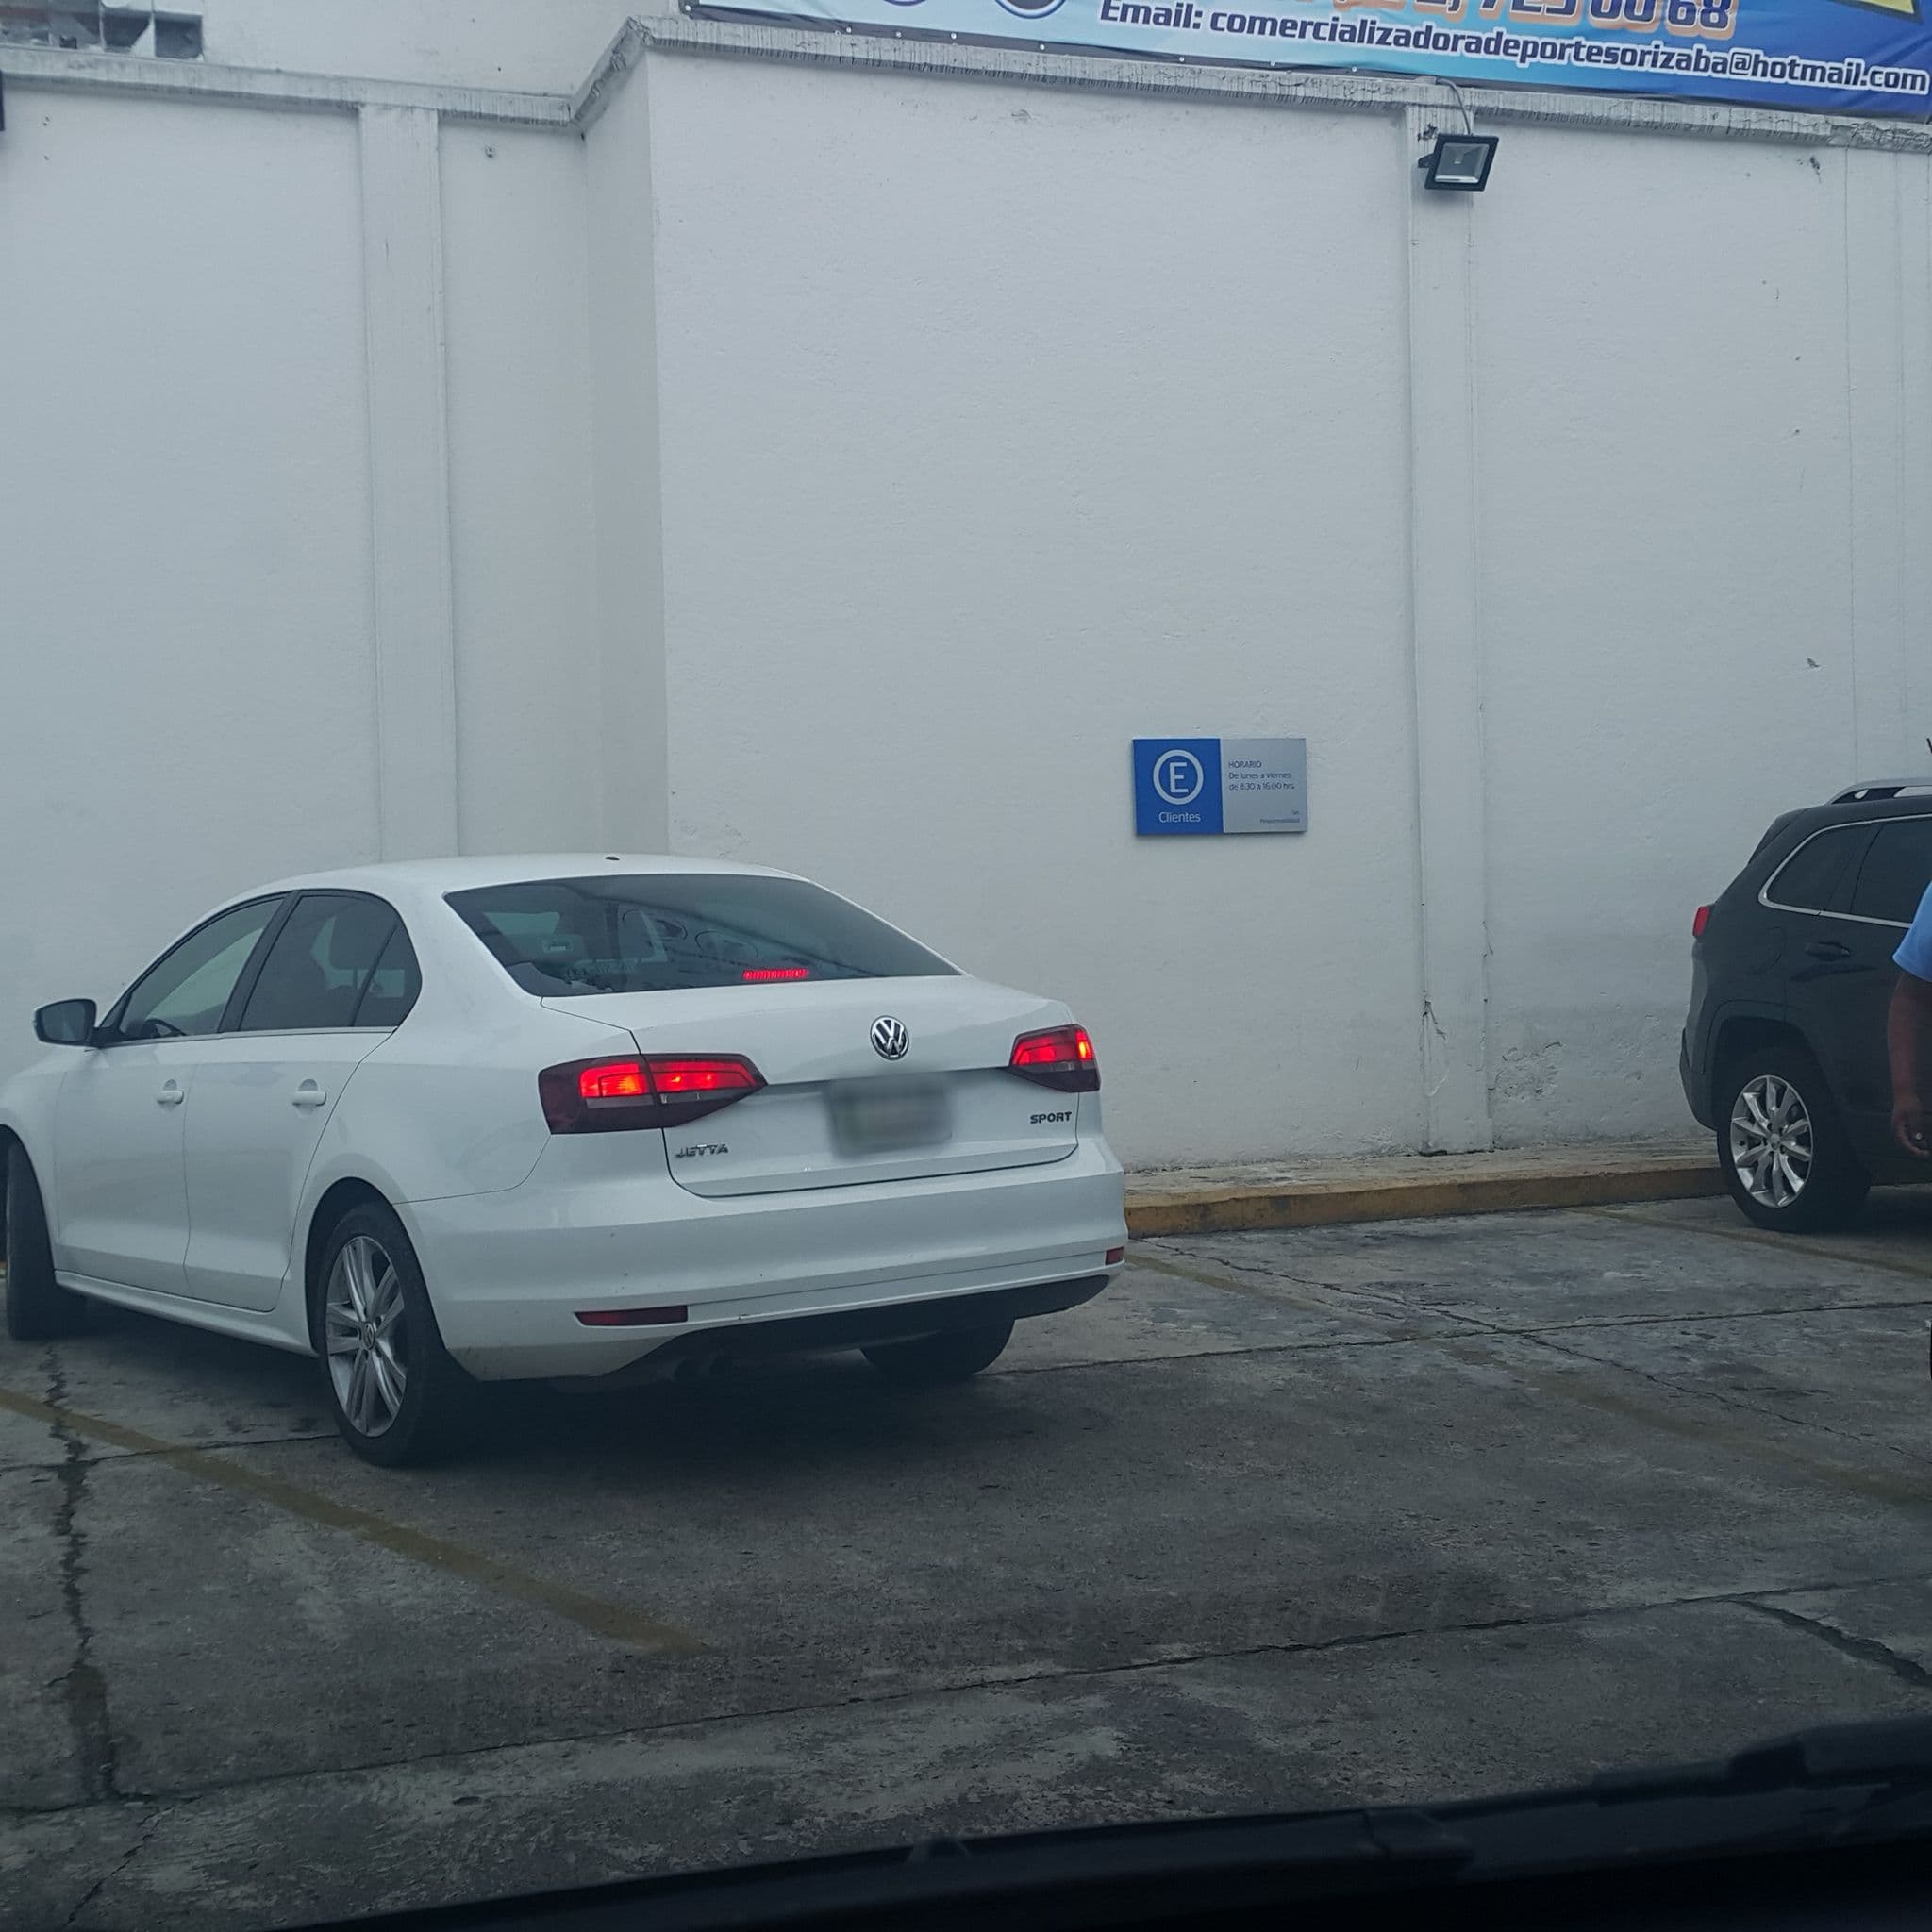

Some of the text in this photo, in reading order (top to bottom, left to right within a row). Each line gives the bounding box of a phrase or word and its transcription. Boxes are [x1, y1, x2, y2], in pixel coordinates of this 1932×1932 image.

[1100, 0, 1927, 92] Email: comercializadoradeportesorizaba@hotmail.com
[1228, 760, 1262, 769] HORARIO
[1169, 761, 1189, 793] E
[1228, 772, 1239, 780] De
[1228, 782, 1239, 791] de
[1158, 811, 1201, 824] Clientes
[1030, 1111, 1072, 1124] SPORT
[675, 1143, 729, 1158] JETTA
